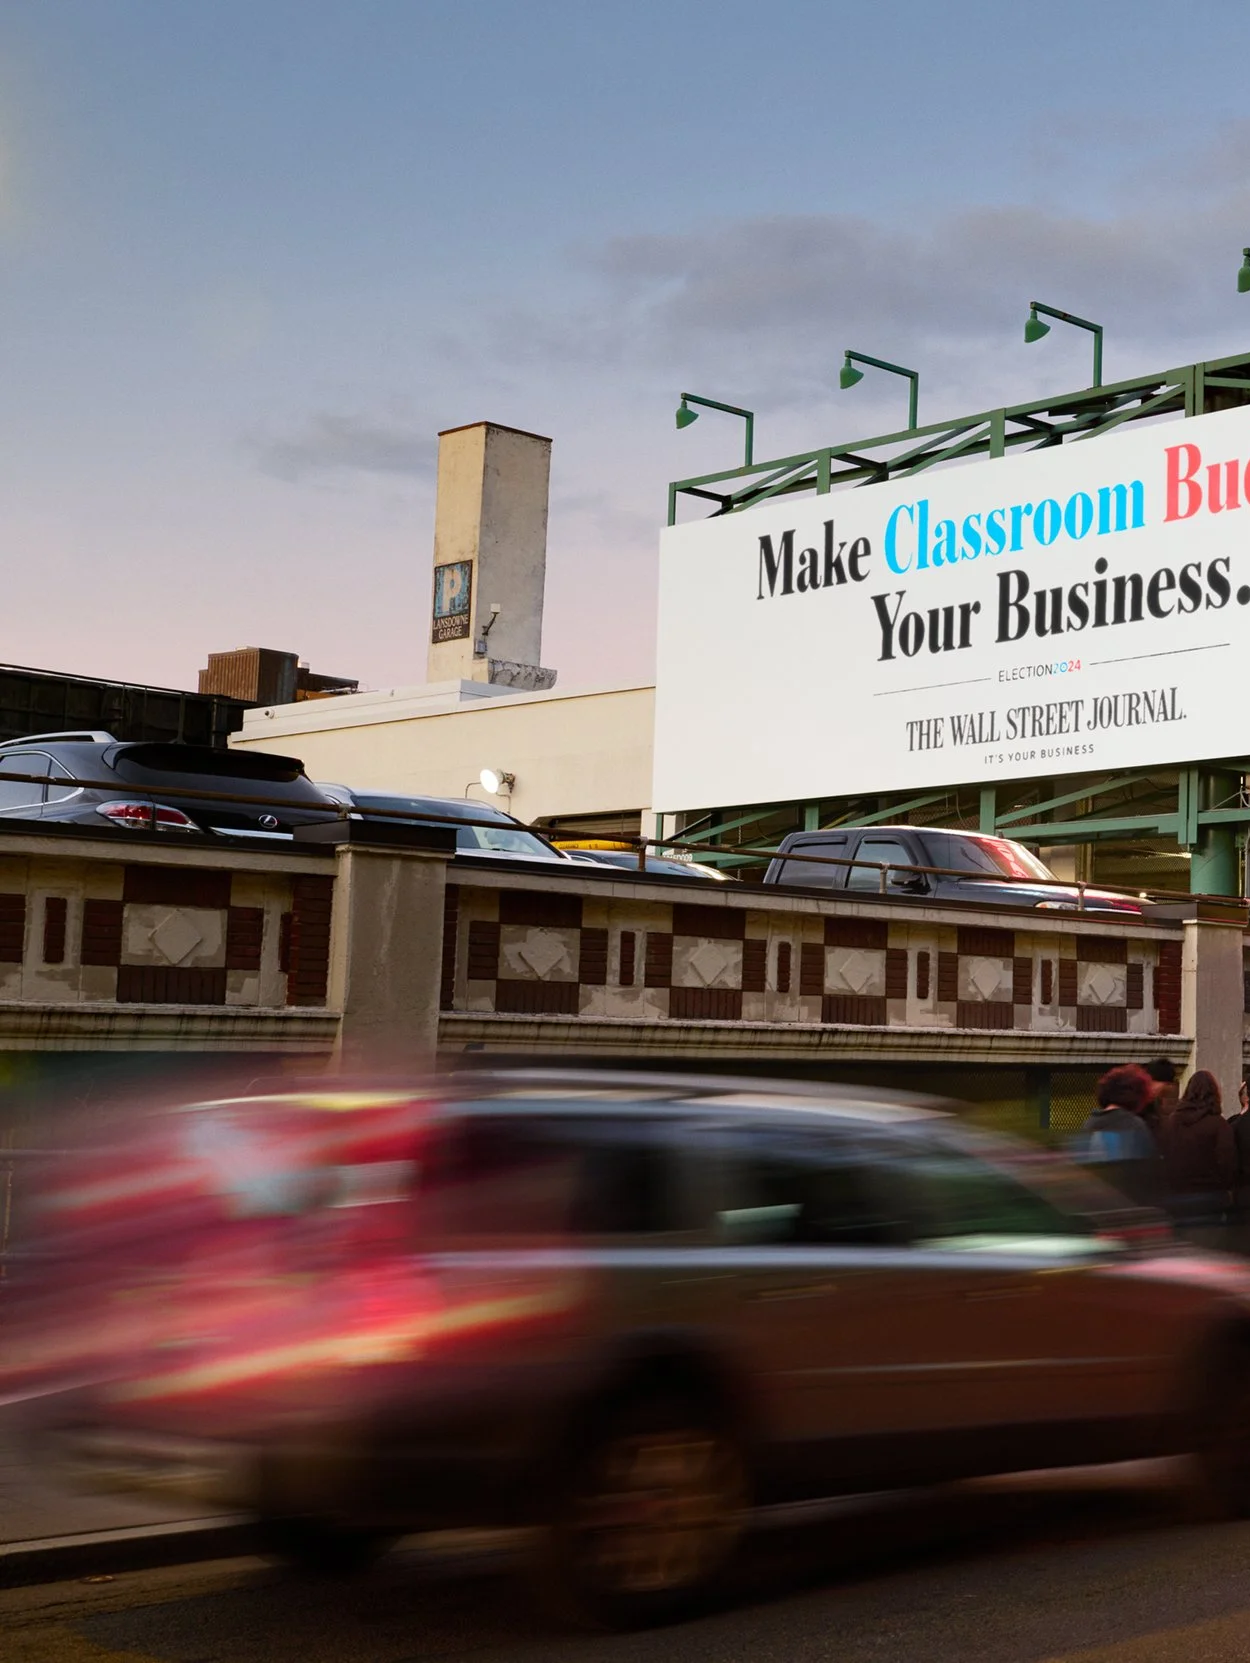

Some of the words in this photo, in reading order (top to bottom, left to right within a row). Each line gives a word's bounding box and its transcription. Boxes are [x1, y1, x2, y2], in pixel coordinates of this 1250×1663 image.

[757, 520, 871, 600] Make
[884, 480, 1145, 574] Classroom
[442, 568, 462, 614] P
[434, 615, 468, 629] LANSDOWNE
[438, 627, 462, 639] GARAGE
[871, 590, 981, 661] Your
[998, 659, 1082, 682] ELECTION2024
[906, 717, 944, 752] THE
[950, 711, 1001, 746] WALL
[1006, 699, 1084, 740] STREET
[1086, 687, 1187, 731] JOURNAL.
[984, 753, 1004, 764] IT'S
[1008, 750, 1036, 761] YOUR
[1041, 743, 1095, 758] BUSINESS
